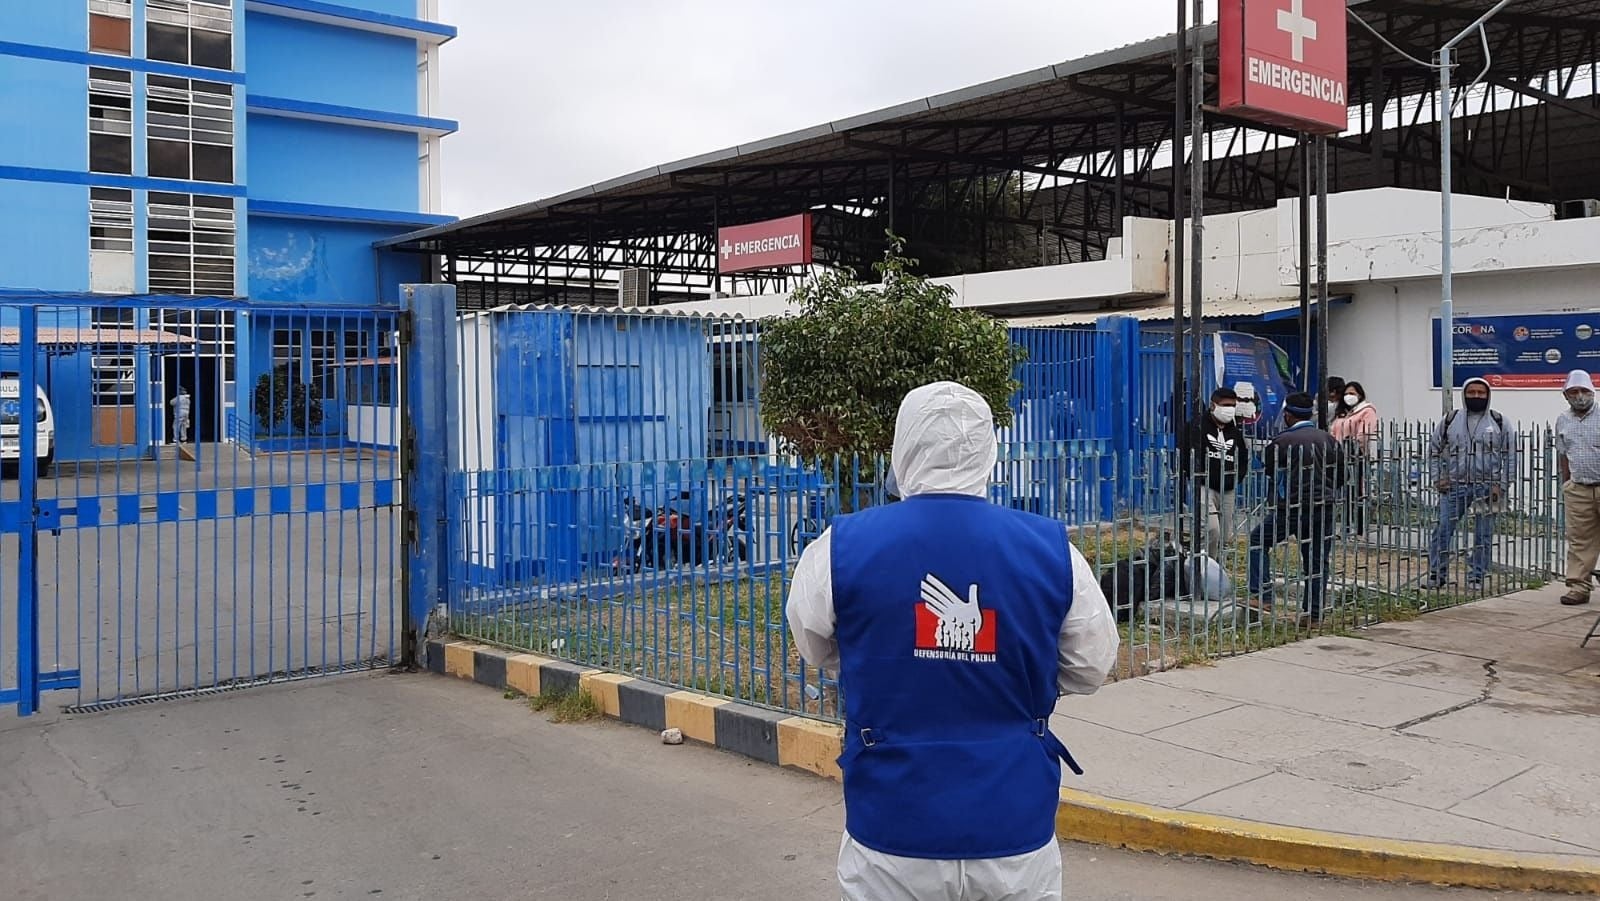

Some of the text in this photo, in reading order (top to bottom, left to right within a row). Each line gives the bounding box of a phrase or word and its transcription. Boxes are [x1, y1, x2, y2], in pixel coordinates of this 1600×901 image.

[1248, 56, 1345, 106] EMERGENCIA
[734, 234, 800, 256] EMERGENCIA
[957, 652, 969, 660] DEL
[971, 653, 996, 662] PUEBLO
